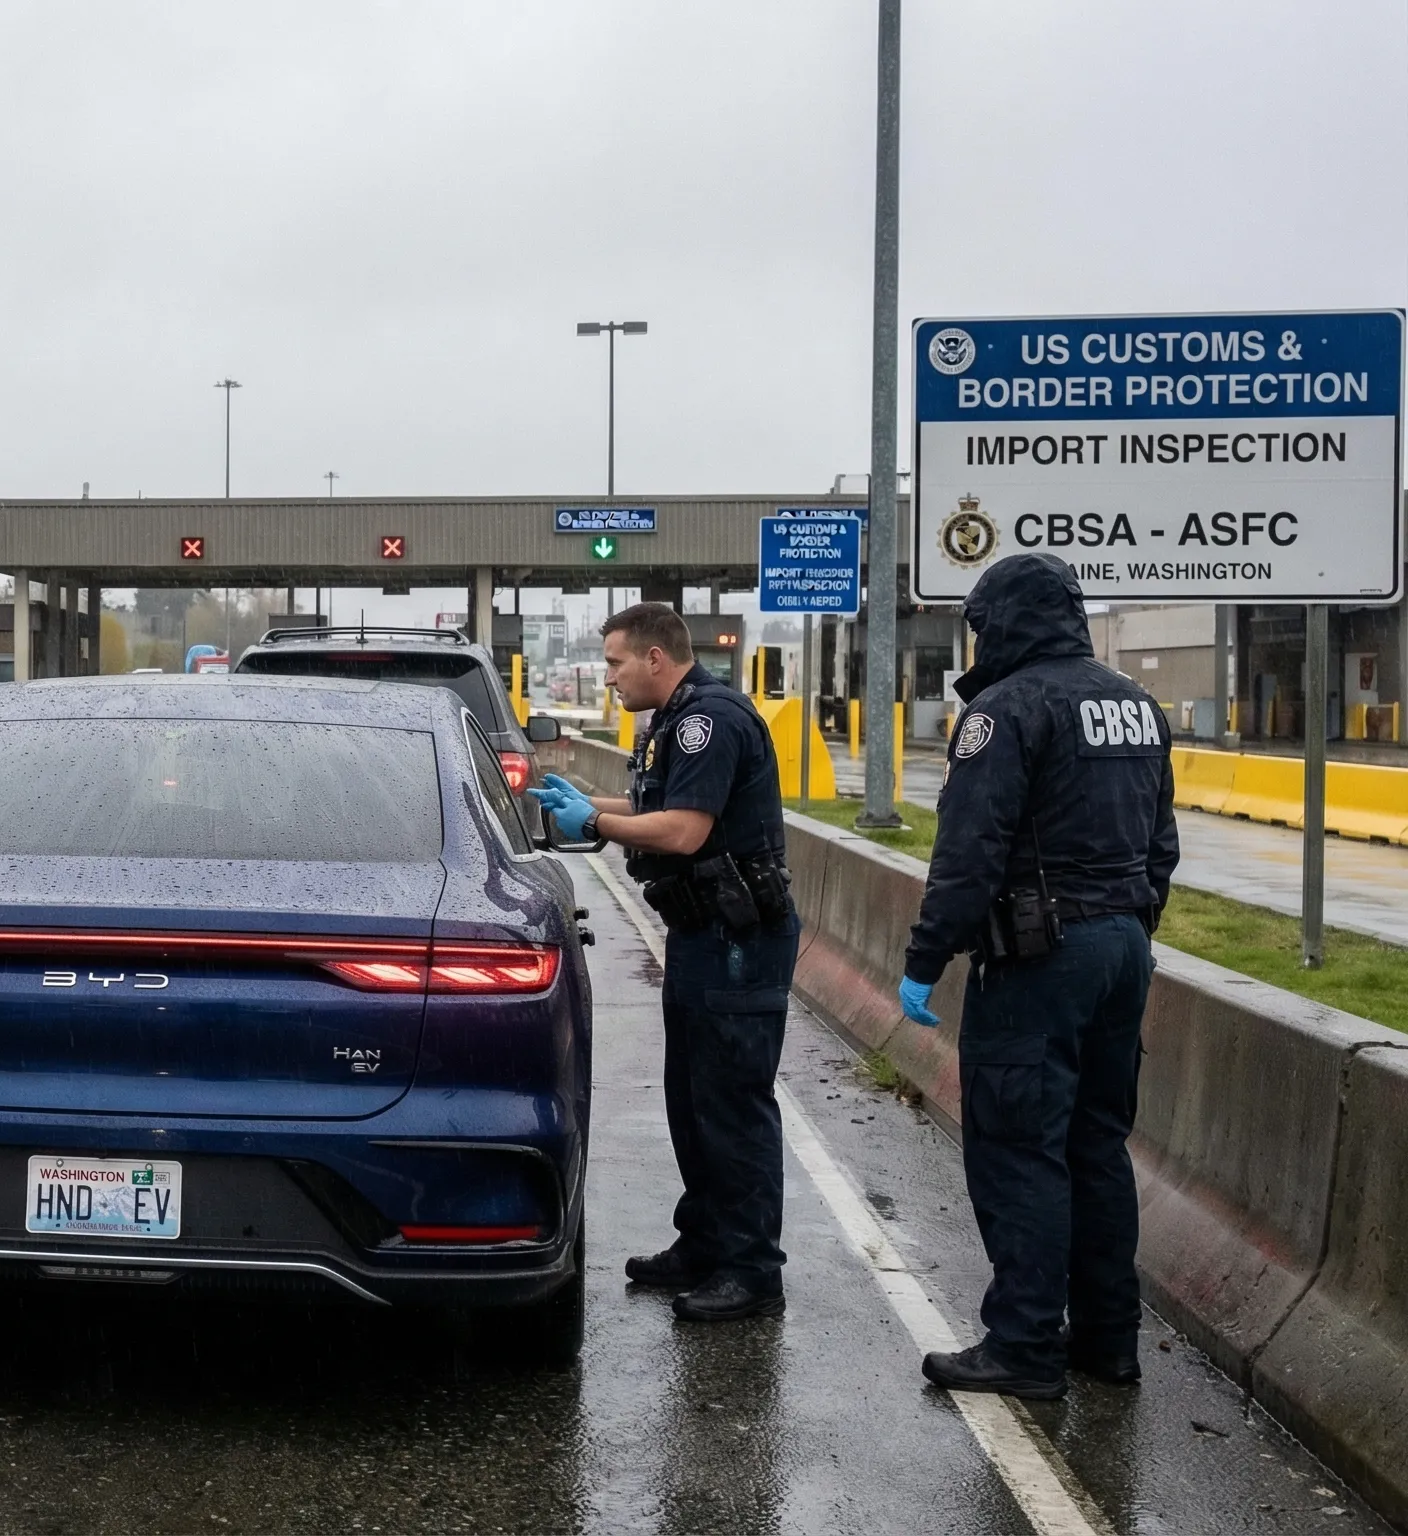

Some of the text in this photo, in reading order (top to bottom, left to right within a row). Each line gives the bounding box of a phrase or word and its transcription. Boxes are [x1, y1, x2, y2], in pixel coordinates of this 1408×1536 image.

[1021, 329, 1303, 365] US CUSTOMS &
[958, 372, 1368, 408] BORDER PROTECTION
[966, 431, 1347, 465] IMPORT INSPECTION
[1014, 512, 1137, 548] CBSA
[1150, 529, 1165, 537] -
[1177, 511, 1298, 547] ASFC
[1069, 562, 1272, 584] AINE, WASHINGTON
[1079, 699, 1161, 747] CBSA
[42, 971, 169, 988] BYD
[333, 1046, 381, 1060] HAN
[351, 1062, 381, 1073] EV
[40, 1168, 125, 1183] WASHINGTON
[36, 1183, 171, 1225] HND EV
